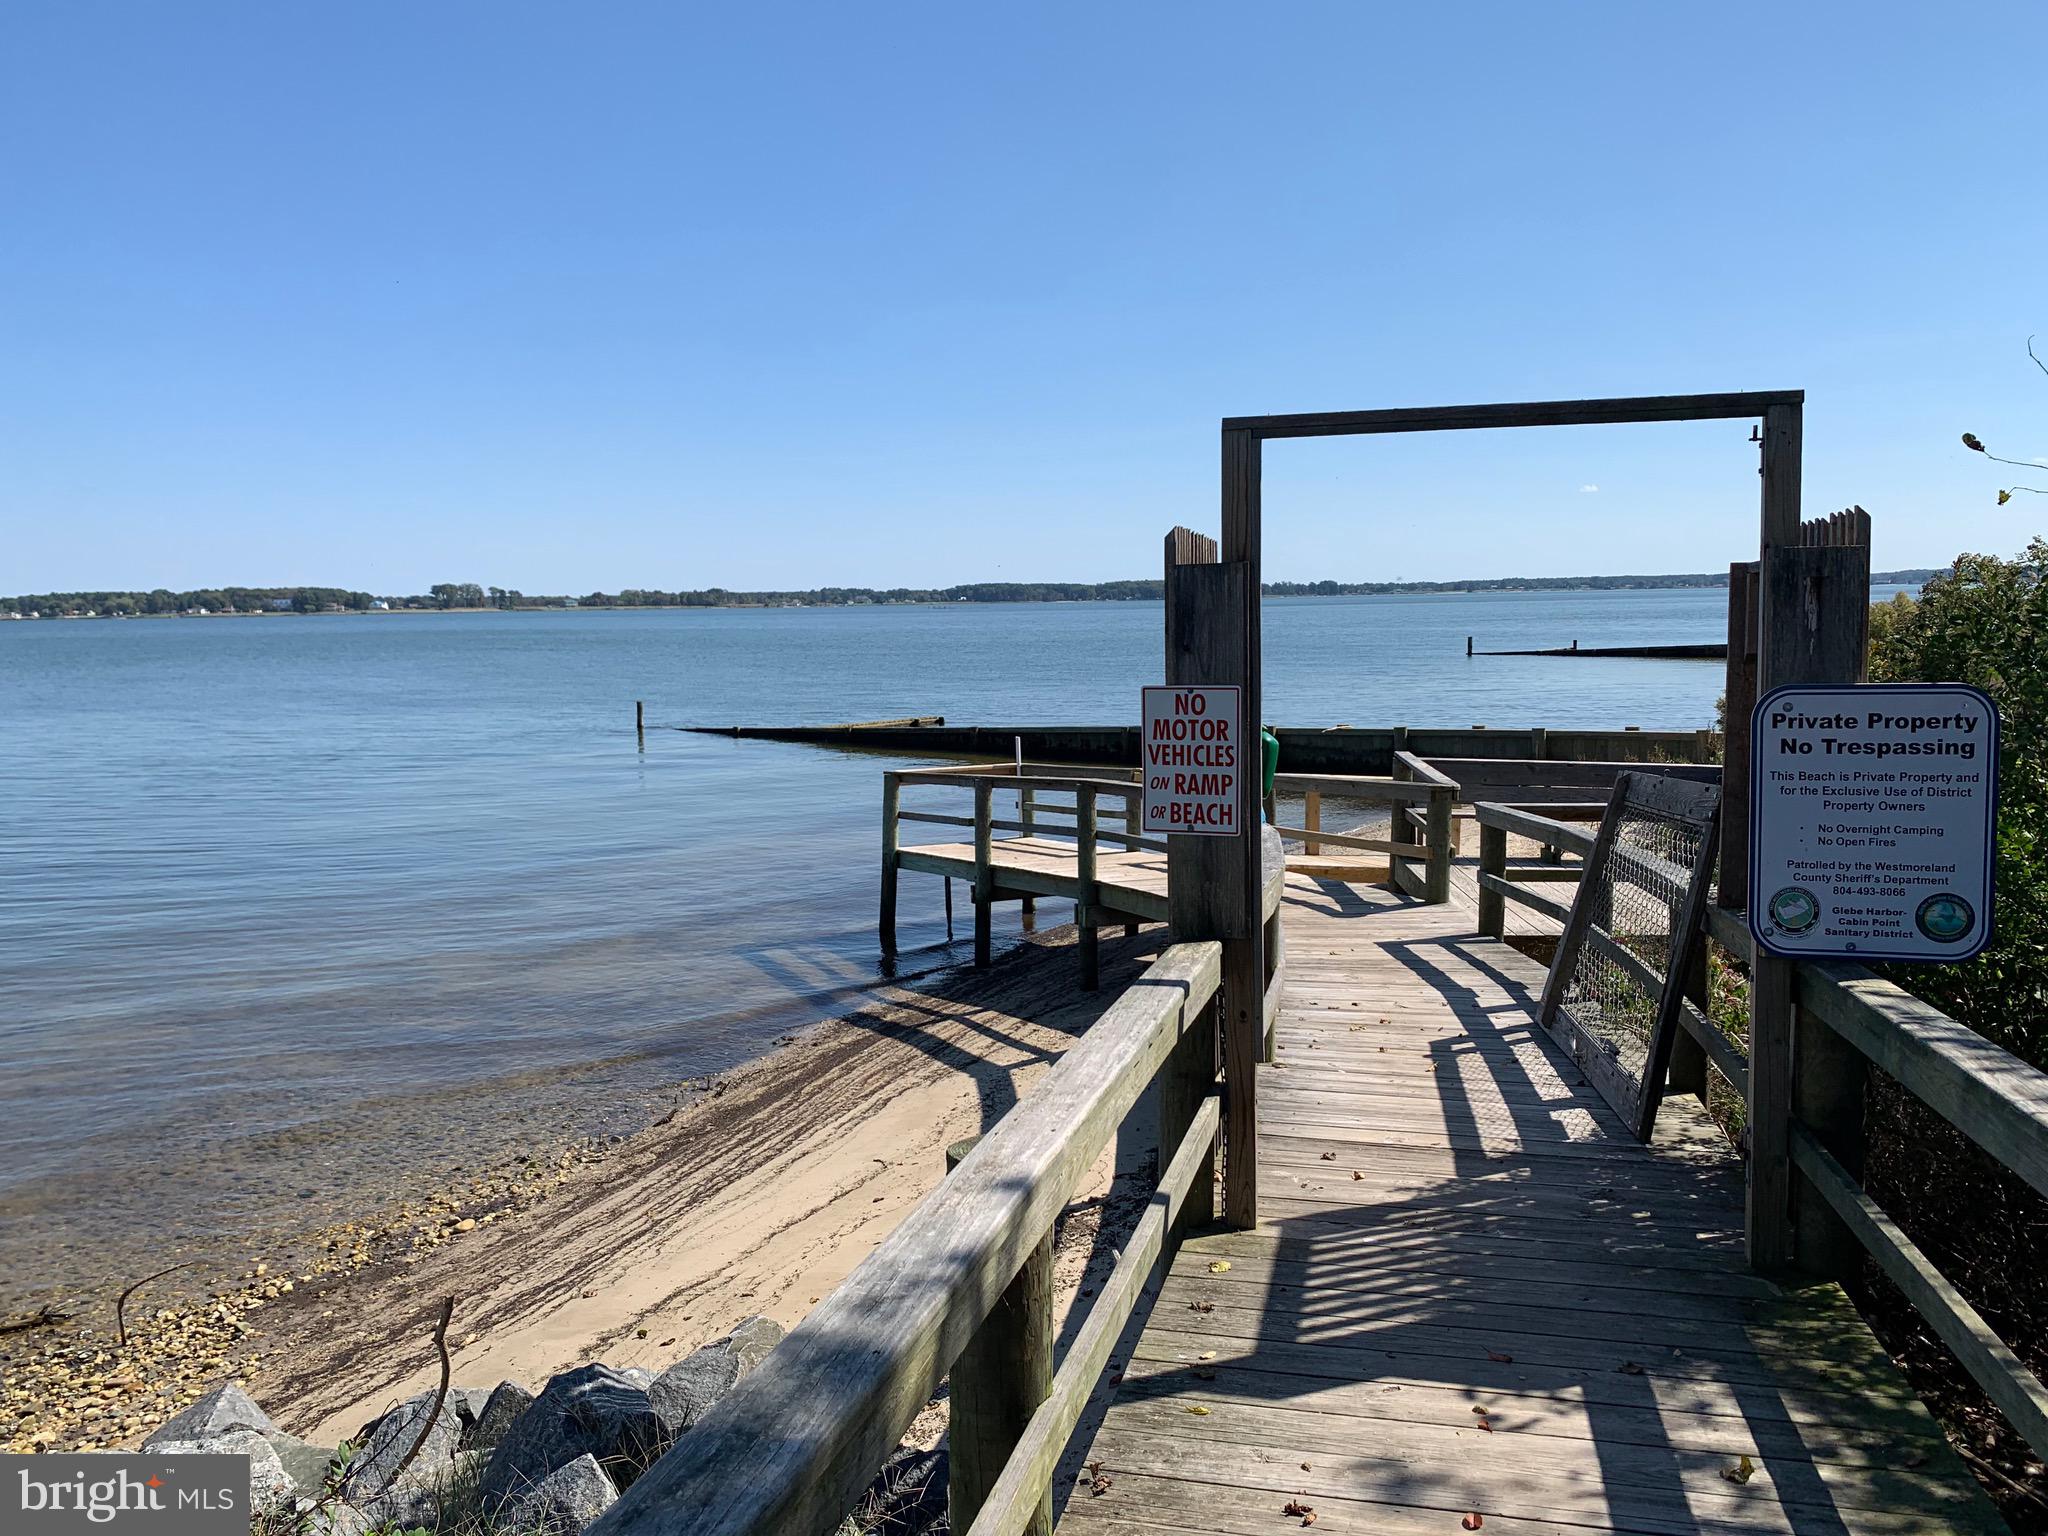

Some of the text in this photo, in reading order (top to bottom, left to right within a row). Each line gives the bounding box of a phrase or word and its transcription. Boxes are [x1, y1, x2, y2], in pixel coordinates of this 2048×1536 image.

[1175, 693, 1206, 716] NO
[1771, 712, 1979, 733] Private Property
[1152, 719, 1229, 742] MOTOR
[1147, 744, 1235, 767] VEHICLES
[1780, 738, 1976, 760] No Trespassing
[1770, 770, 1979, 784] This Beach is Private Property and
[1150, 773, 1233, 796] ON RAMP
[1780, 785, 1972, 798] for the Exclusive Use of District
[1823, 800, 1925, 813] Property Owners
[1151, 802, 1233, 826] OR BEACH
[1818, 824, 1944, 837] No Overnight Camping
[1818, 836, 1897, 849] No Open Fires
[1787, 860, 1956, 873] Patrolled by the Westmoreland
[1793, 873, 1949, 887] County Sheriff's Department
[1833, 886, 1906, 897] 804-493-8066
[1832, 906, 1863, 916] Glebe
[1838, 917, 1900, 927] Cabin Point
[1824, 927, 1913, 939] Sanitary District
